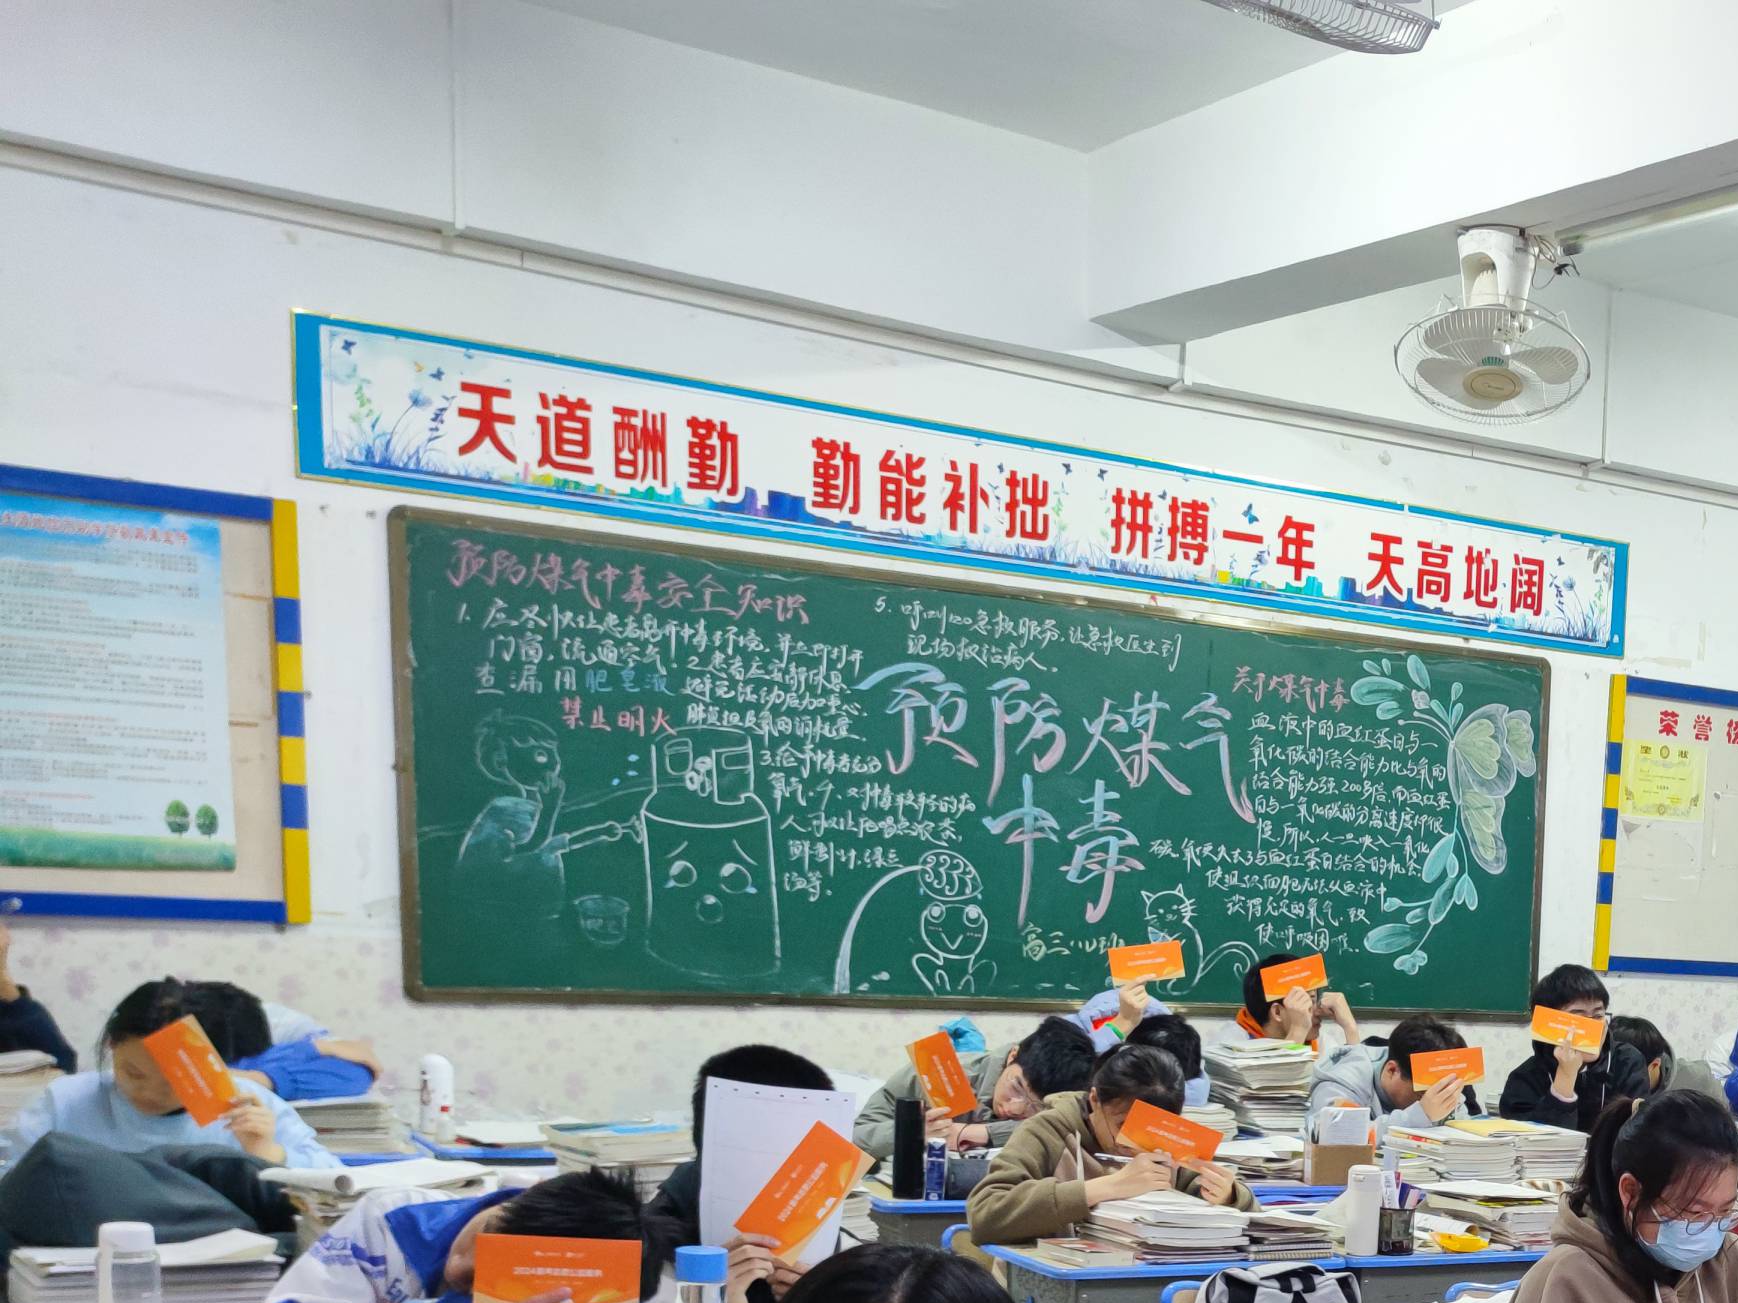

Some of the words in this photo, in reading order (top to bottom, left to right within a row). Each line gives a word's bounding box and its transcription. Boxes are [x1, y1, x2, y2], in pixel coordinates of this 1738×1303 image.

[457, 382, 740, 498] 天道酬勤
[812, 438, 1051, 542] 勤能补拙
[1111, 487, 1317, 582] 拼搏一年
[1368, 530, 1545, 618] 天高地阔
[447, 539, 809, 626] 预防煤气中毒安全知识
[561, 698, 678, 737] 禁止明火
[853, 660, 1258, 824] 预防煤气
[1231, 664, 1351, 713] 关于煤气中毒
[981, 772, 1146, 928] 中毒
